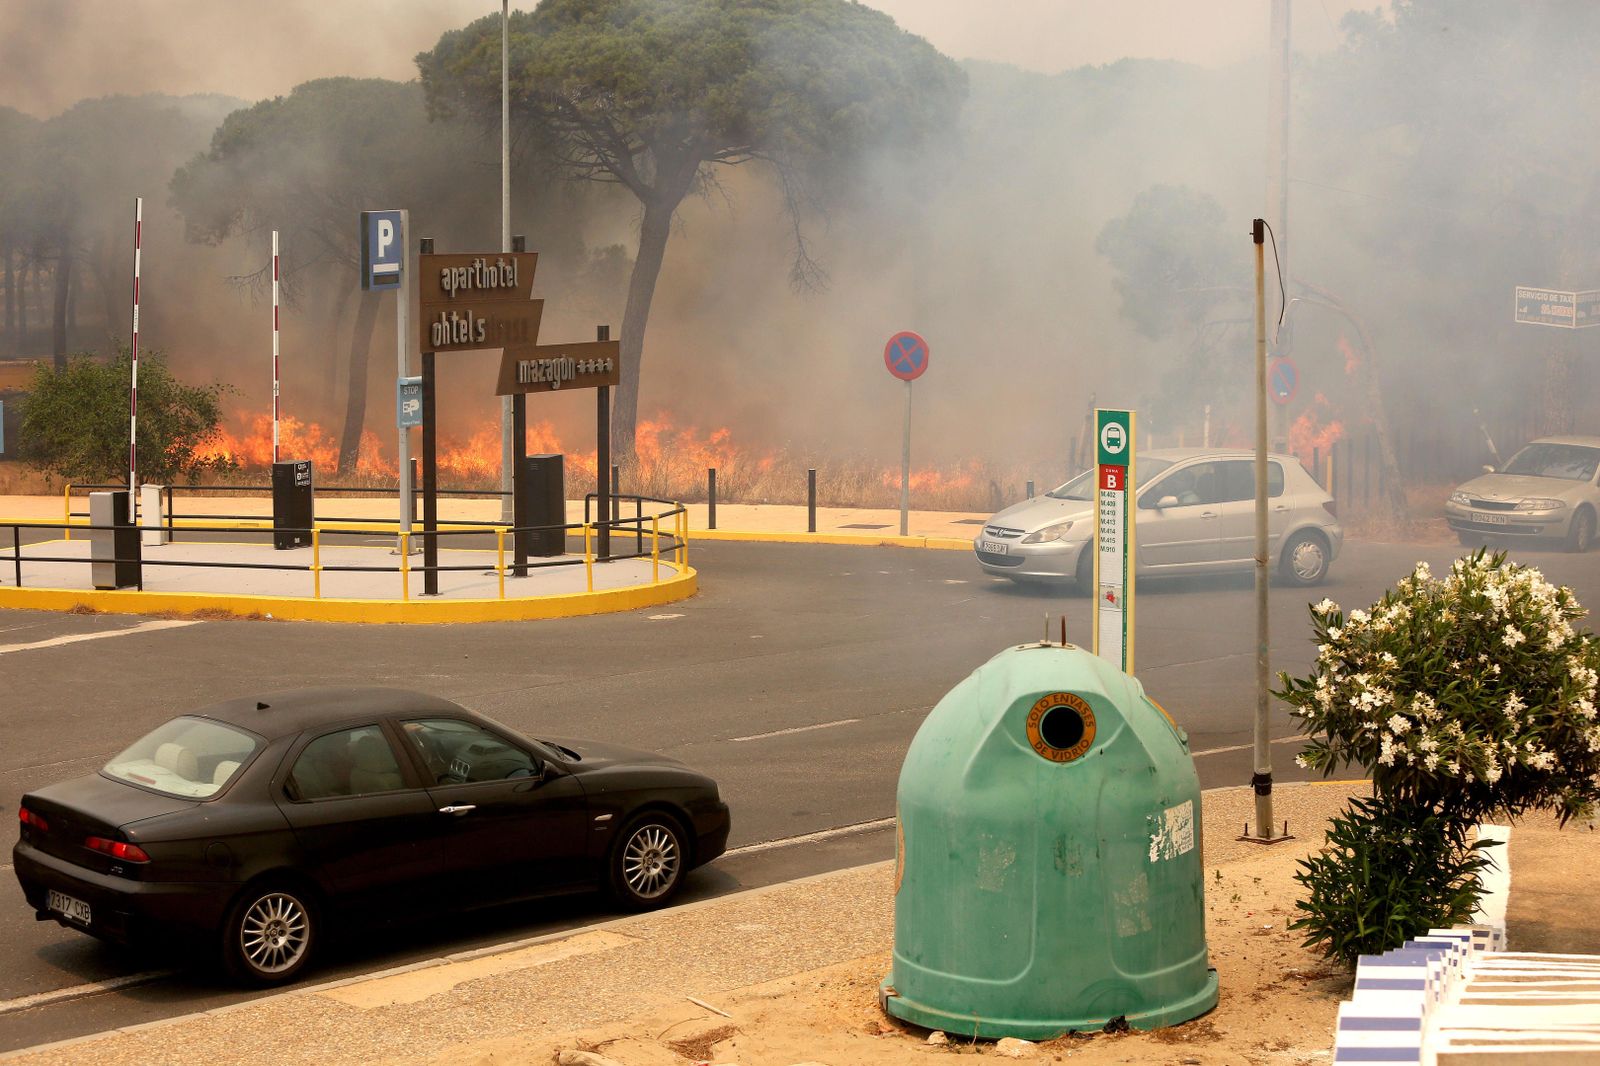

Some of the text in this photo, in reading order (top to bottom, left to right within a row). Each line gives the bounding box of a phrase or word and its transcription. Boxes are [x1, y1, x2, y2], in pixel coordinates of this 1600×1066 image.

[377, 219, 394, 257] P
[440, 257, 519, 298] aparthotel
[431, 309, 486, 347] ohtels
[517, 353, 576, 390] mazagón
[403, 385, 419, 395] STOP
[1107, 474, 1117, 489] B
[1028, 694, 1094, 728] SOLO ENVASES
[1034, 739, 1089, 760] DE VIDRIO
[50, 891, 90, 920] 7317 CXB
